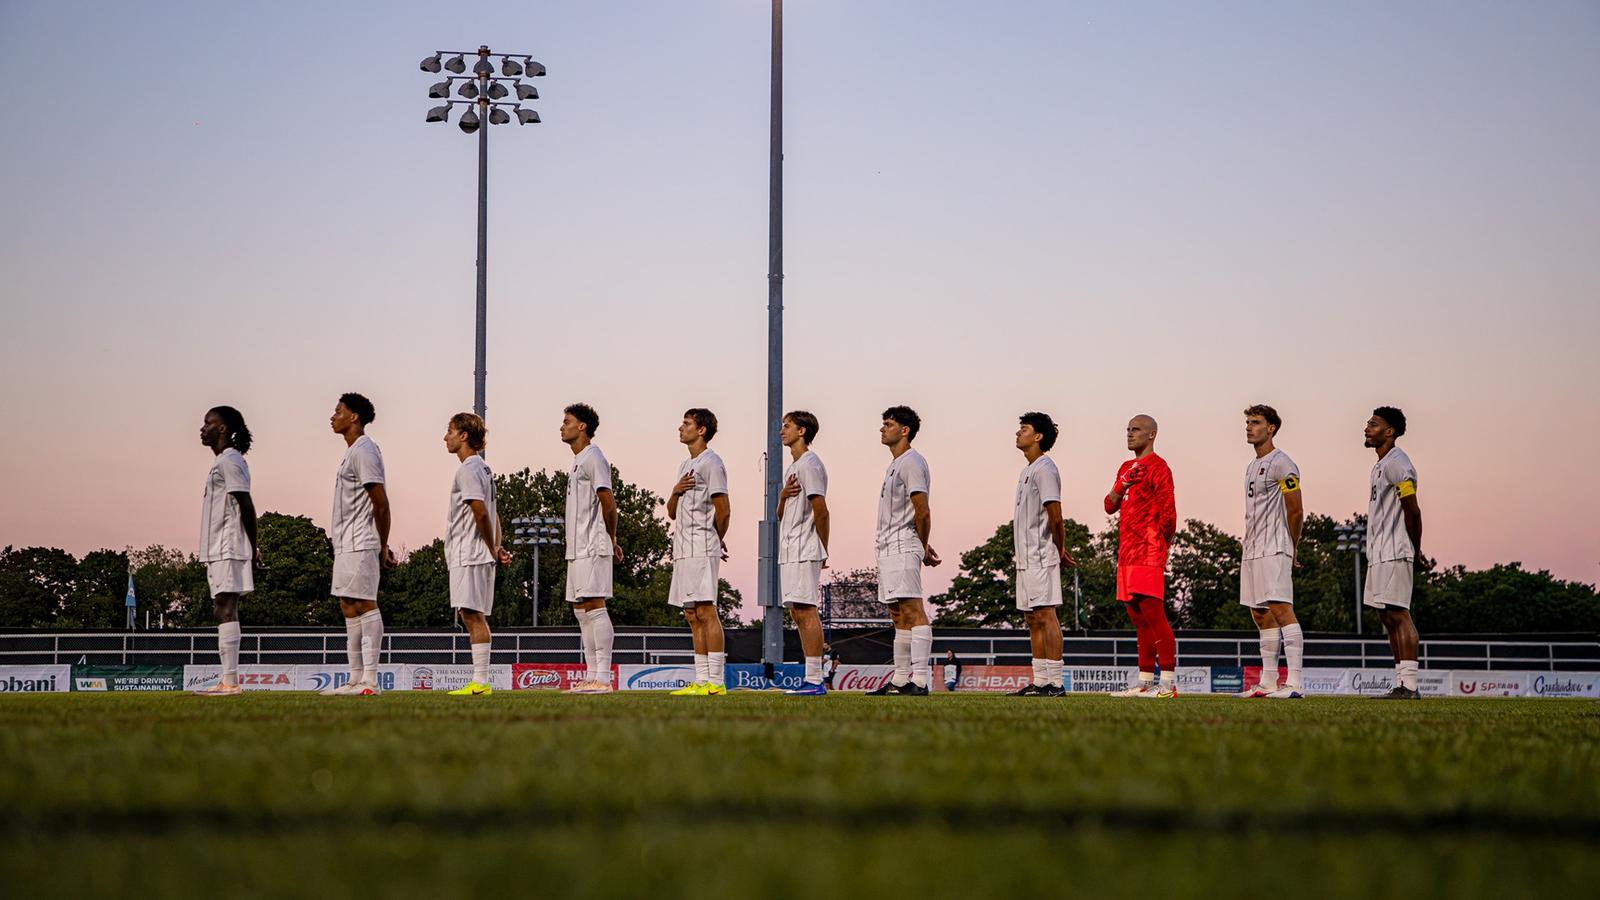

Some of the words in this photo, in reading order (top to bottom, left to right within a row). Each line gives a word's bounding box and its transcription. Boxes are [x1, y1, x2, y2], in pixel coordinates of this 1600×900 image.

[1248, 481, 1255, 498] 5
[114, 677, 139, 685] WE'RE
[140, 677, 173, 685] DRIVING
[239, 674, 291, 685] IZZA
[737, 670, 803, 690] BayCoa
[1073, 670, 1129, 681] UNIVERSITY
[958, 676, 1030, 688] IGHBAR
[1073, 682, 1129, 692] ORTHOPEDICS
